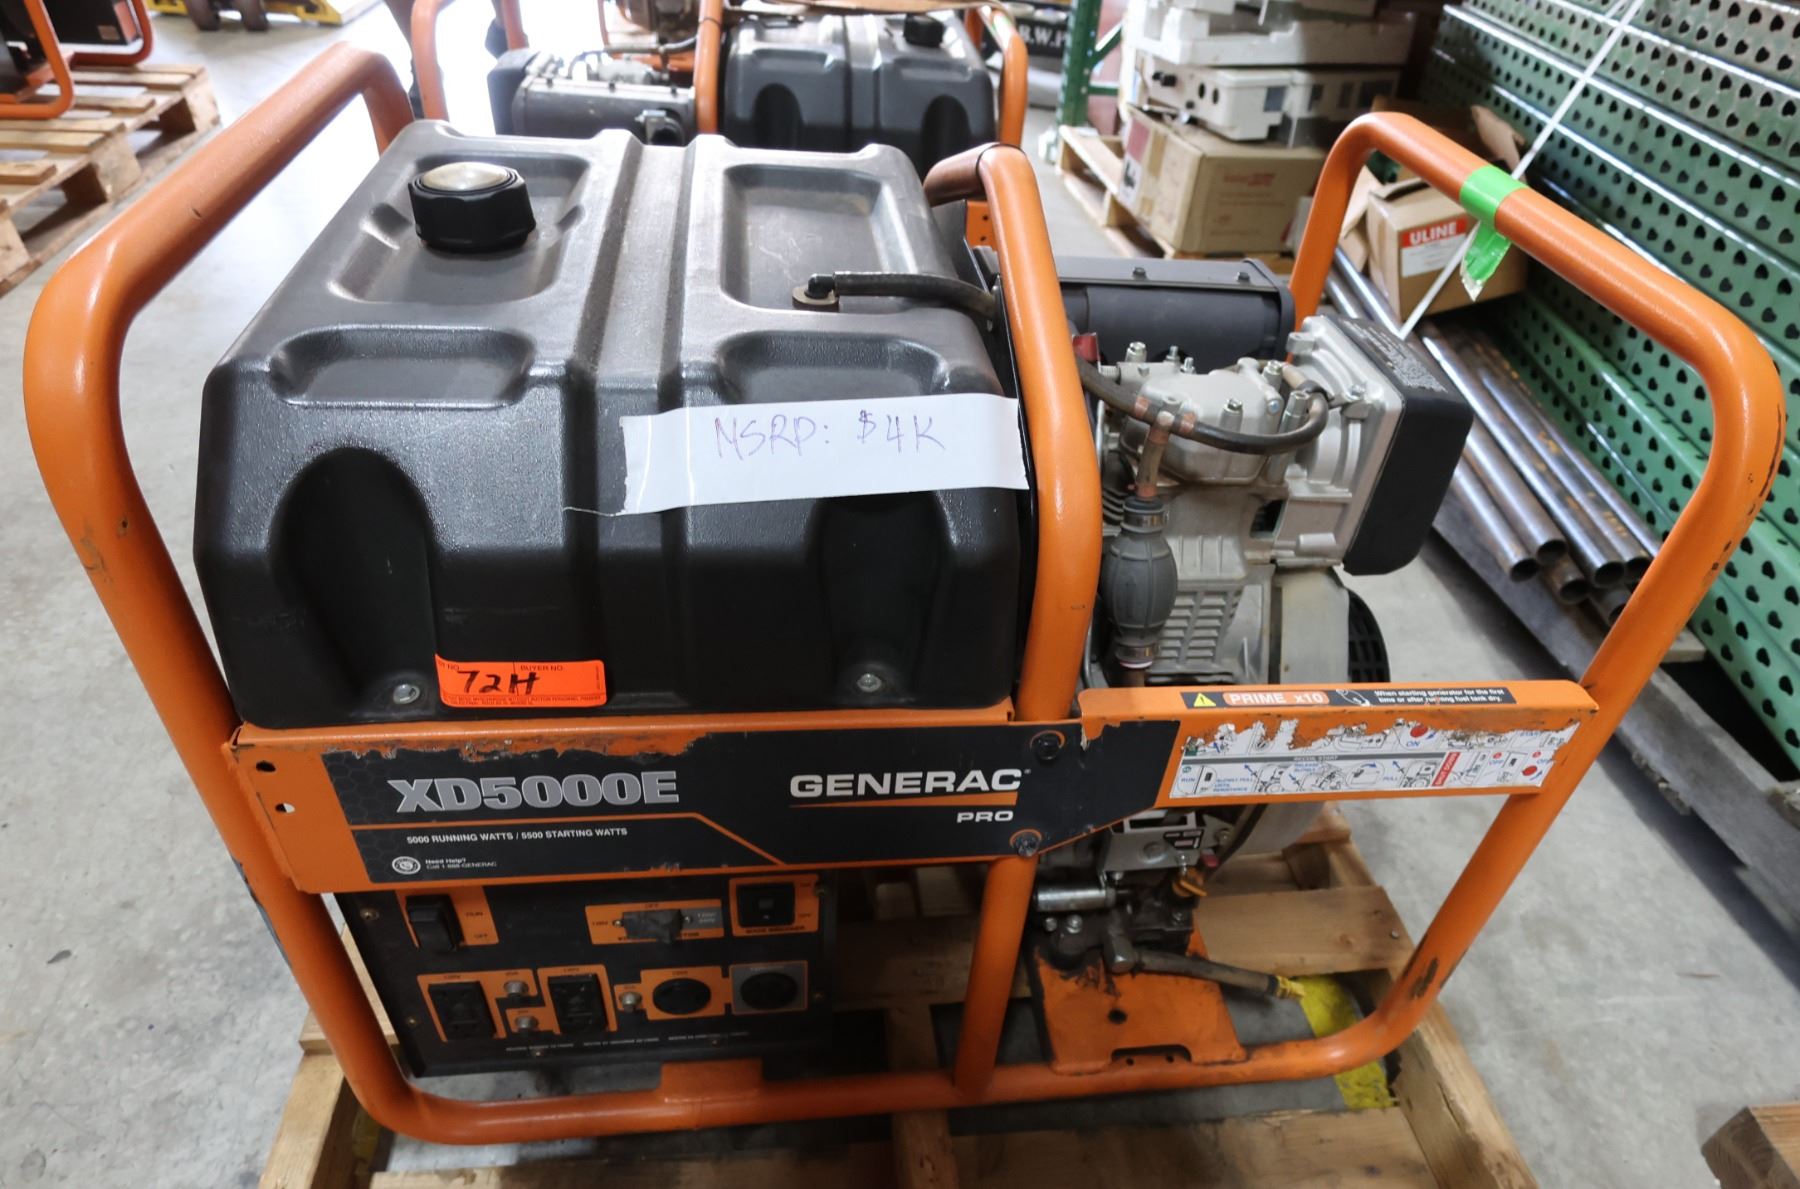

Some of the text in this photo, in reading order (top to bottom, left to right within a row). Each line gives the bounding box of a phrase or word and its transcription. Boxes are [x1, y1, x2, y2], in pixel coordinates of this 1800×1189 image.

[1408, 221, 1457, 246] ULINE
[457, 670, 540, 695] 72H
[1229, 692, 1323, 705] PRIME x10
[386, 770, 680, 814] XD5000E
[790, 769, 1023, 798] GENERAC
[956, 811, 1014, 824] PRO
[406, 835, 430, 845] 5000
[431, 833, 478, 844] RUNNING
[480, 832, 514, 841] WATTS
[521, 830, 544, 840] 5500
[545, 828, 593, 839] STARTING
[595, 827, 629, 837] WATTS
